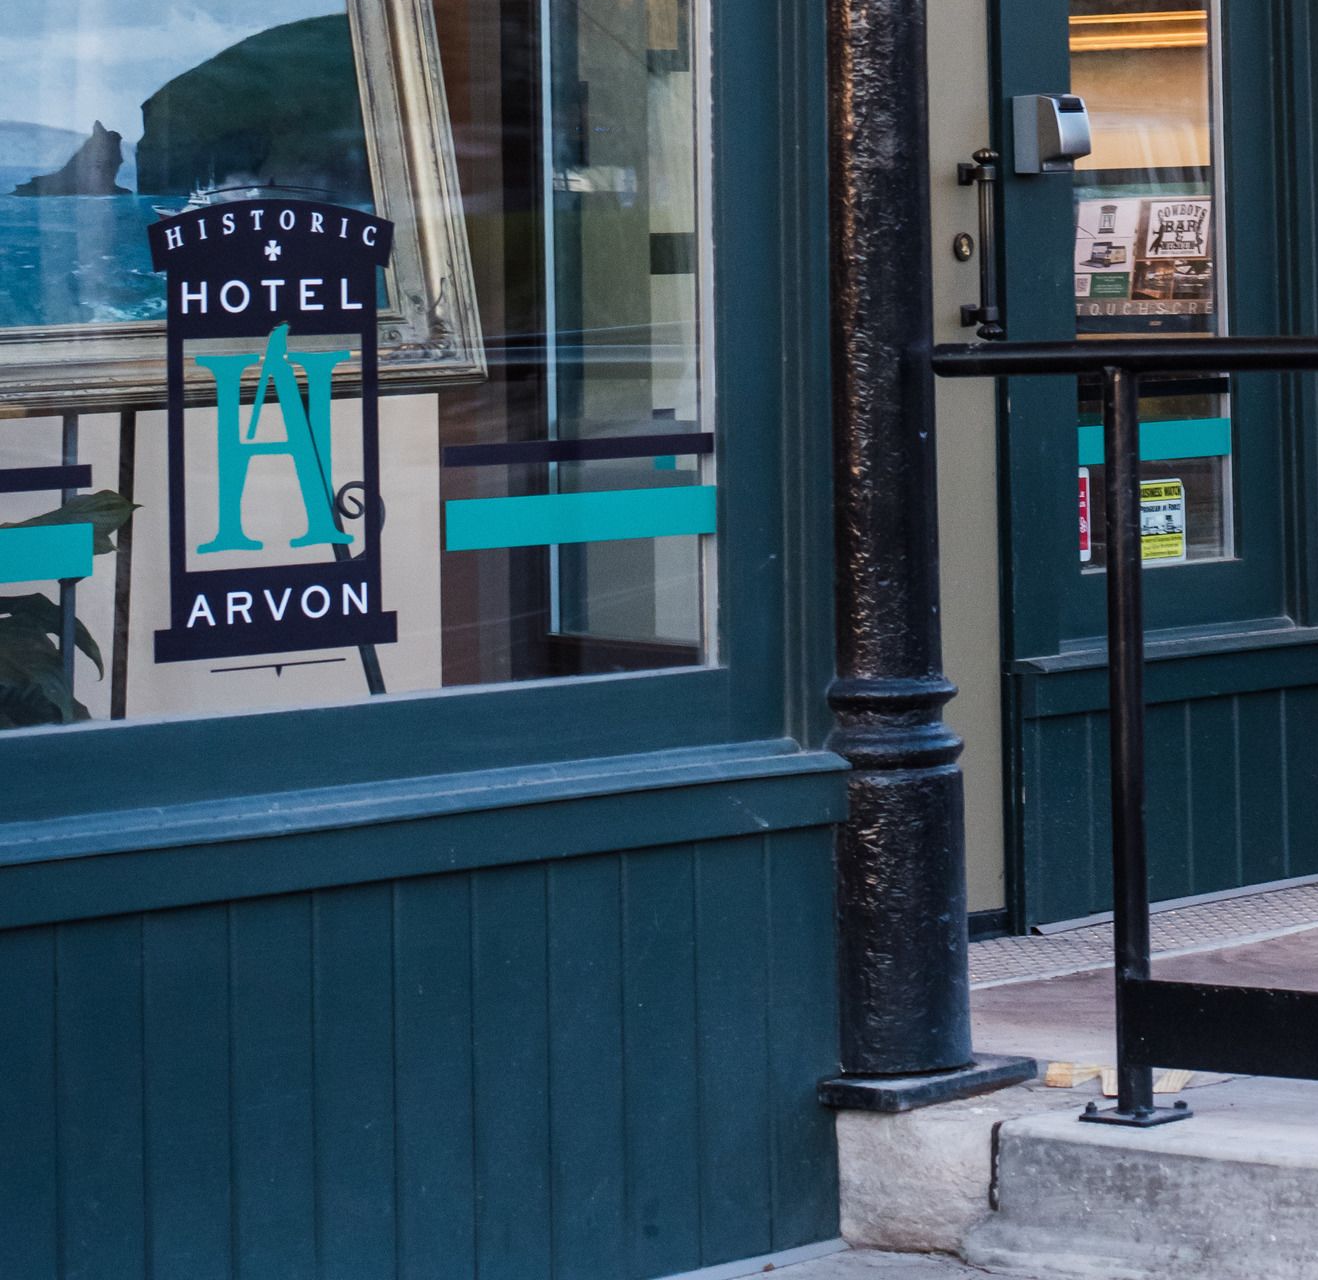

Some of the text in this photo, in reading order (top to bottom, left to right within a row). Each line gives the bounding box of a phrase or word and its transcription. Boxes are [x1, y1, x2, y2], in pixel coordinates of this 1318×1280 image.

[164, 209, 378, 250] HISTORIC
[1157, 204, 1208, 221] COWBOYS
[1164, 220, 1198, 233] BAR
[181, 277, 363, 315] HOTEL
[185, 582, 370, 628] ARVON
